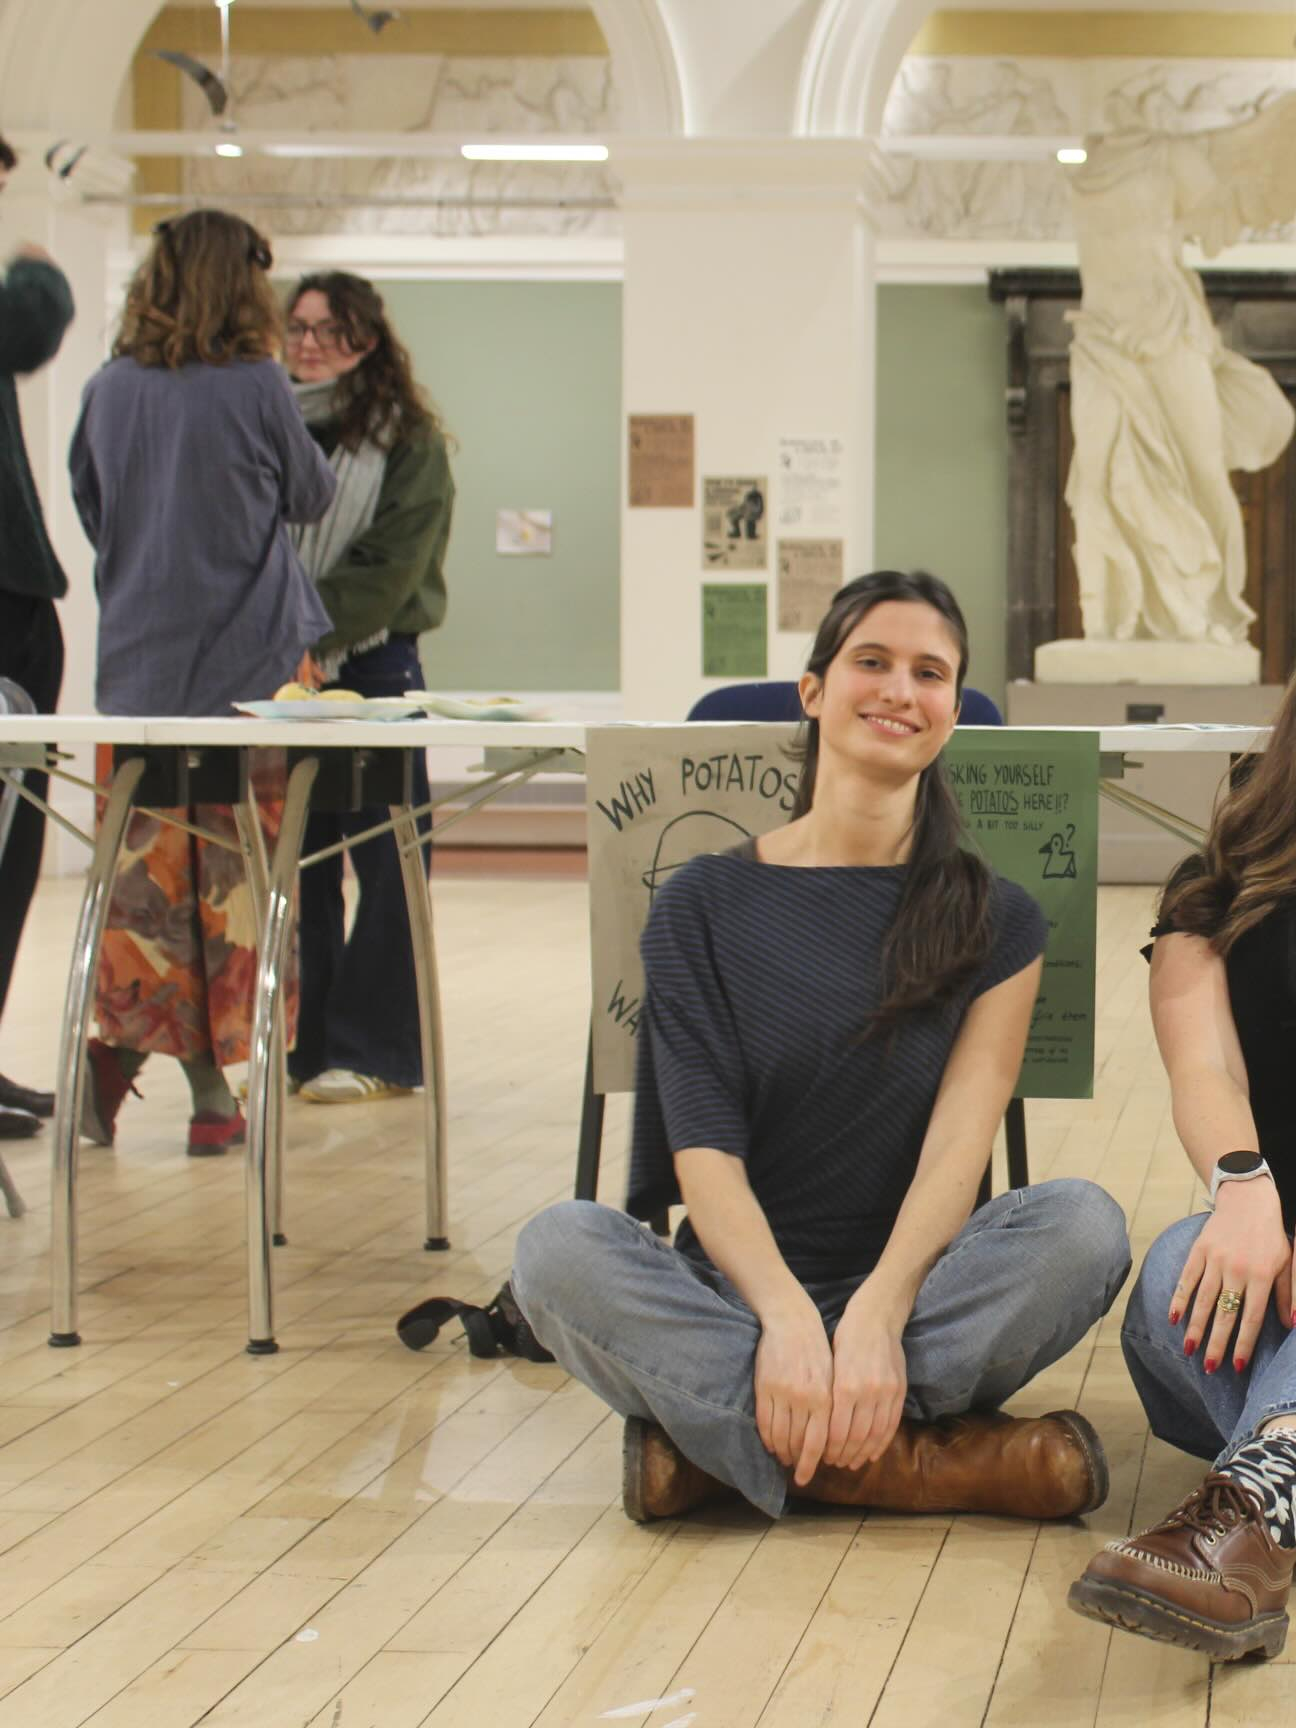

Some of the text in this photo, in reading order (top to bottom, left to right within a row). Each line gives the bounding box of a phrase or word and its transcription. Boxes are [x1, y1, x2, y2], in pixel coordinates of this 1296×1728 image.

[950, 763, 1055, 787] SKING YOURSELF
[596, 768, 656, 832] WHY
[969, 789, 1019, 812] POTATOS
